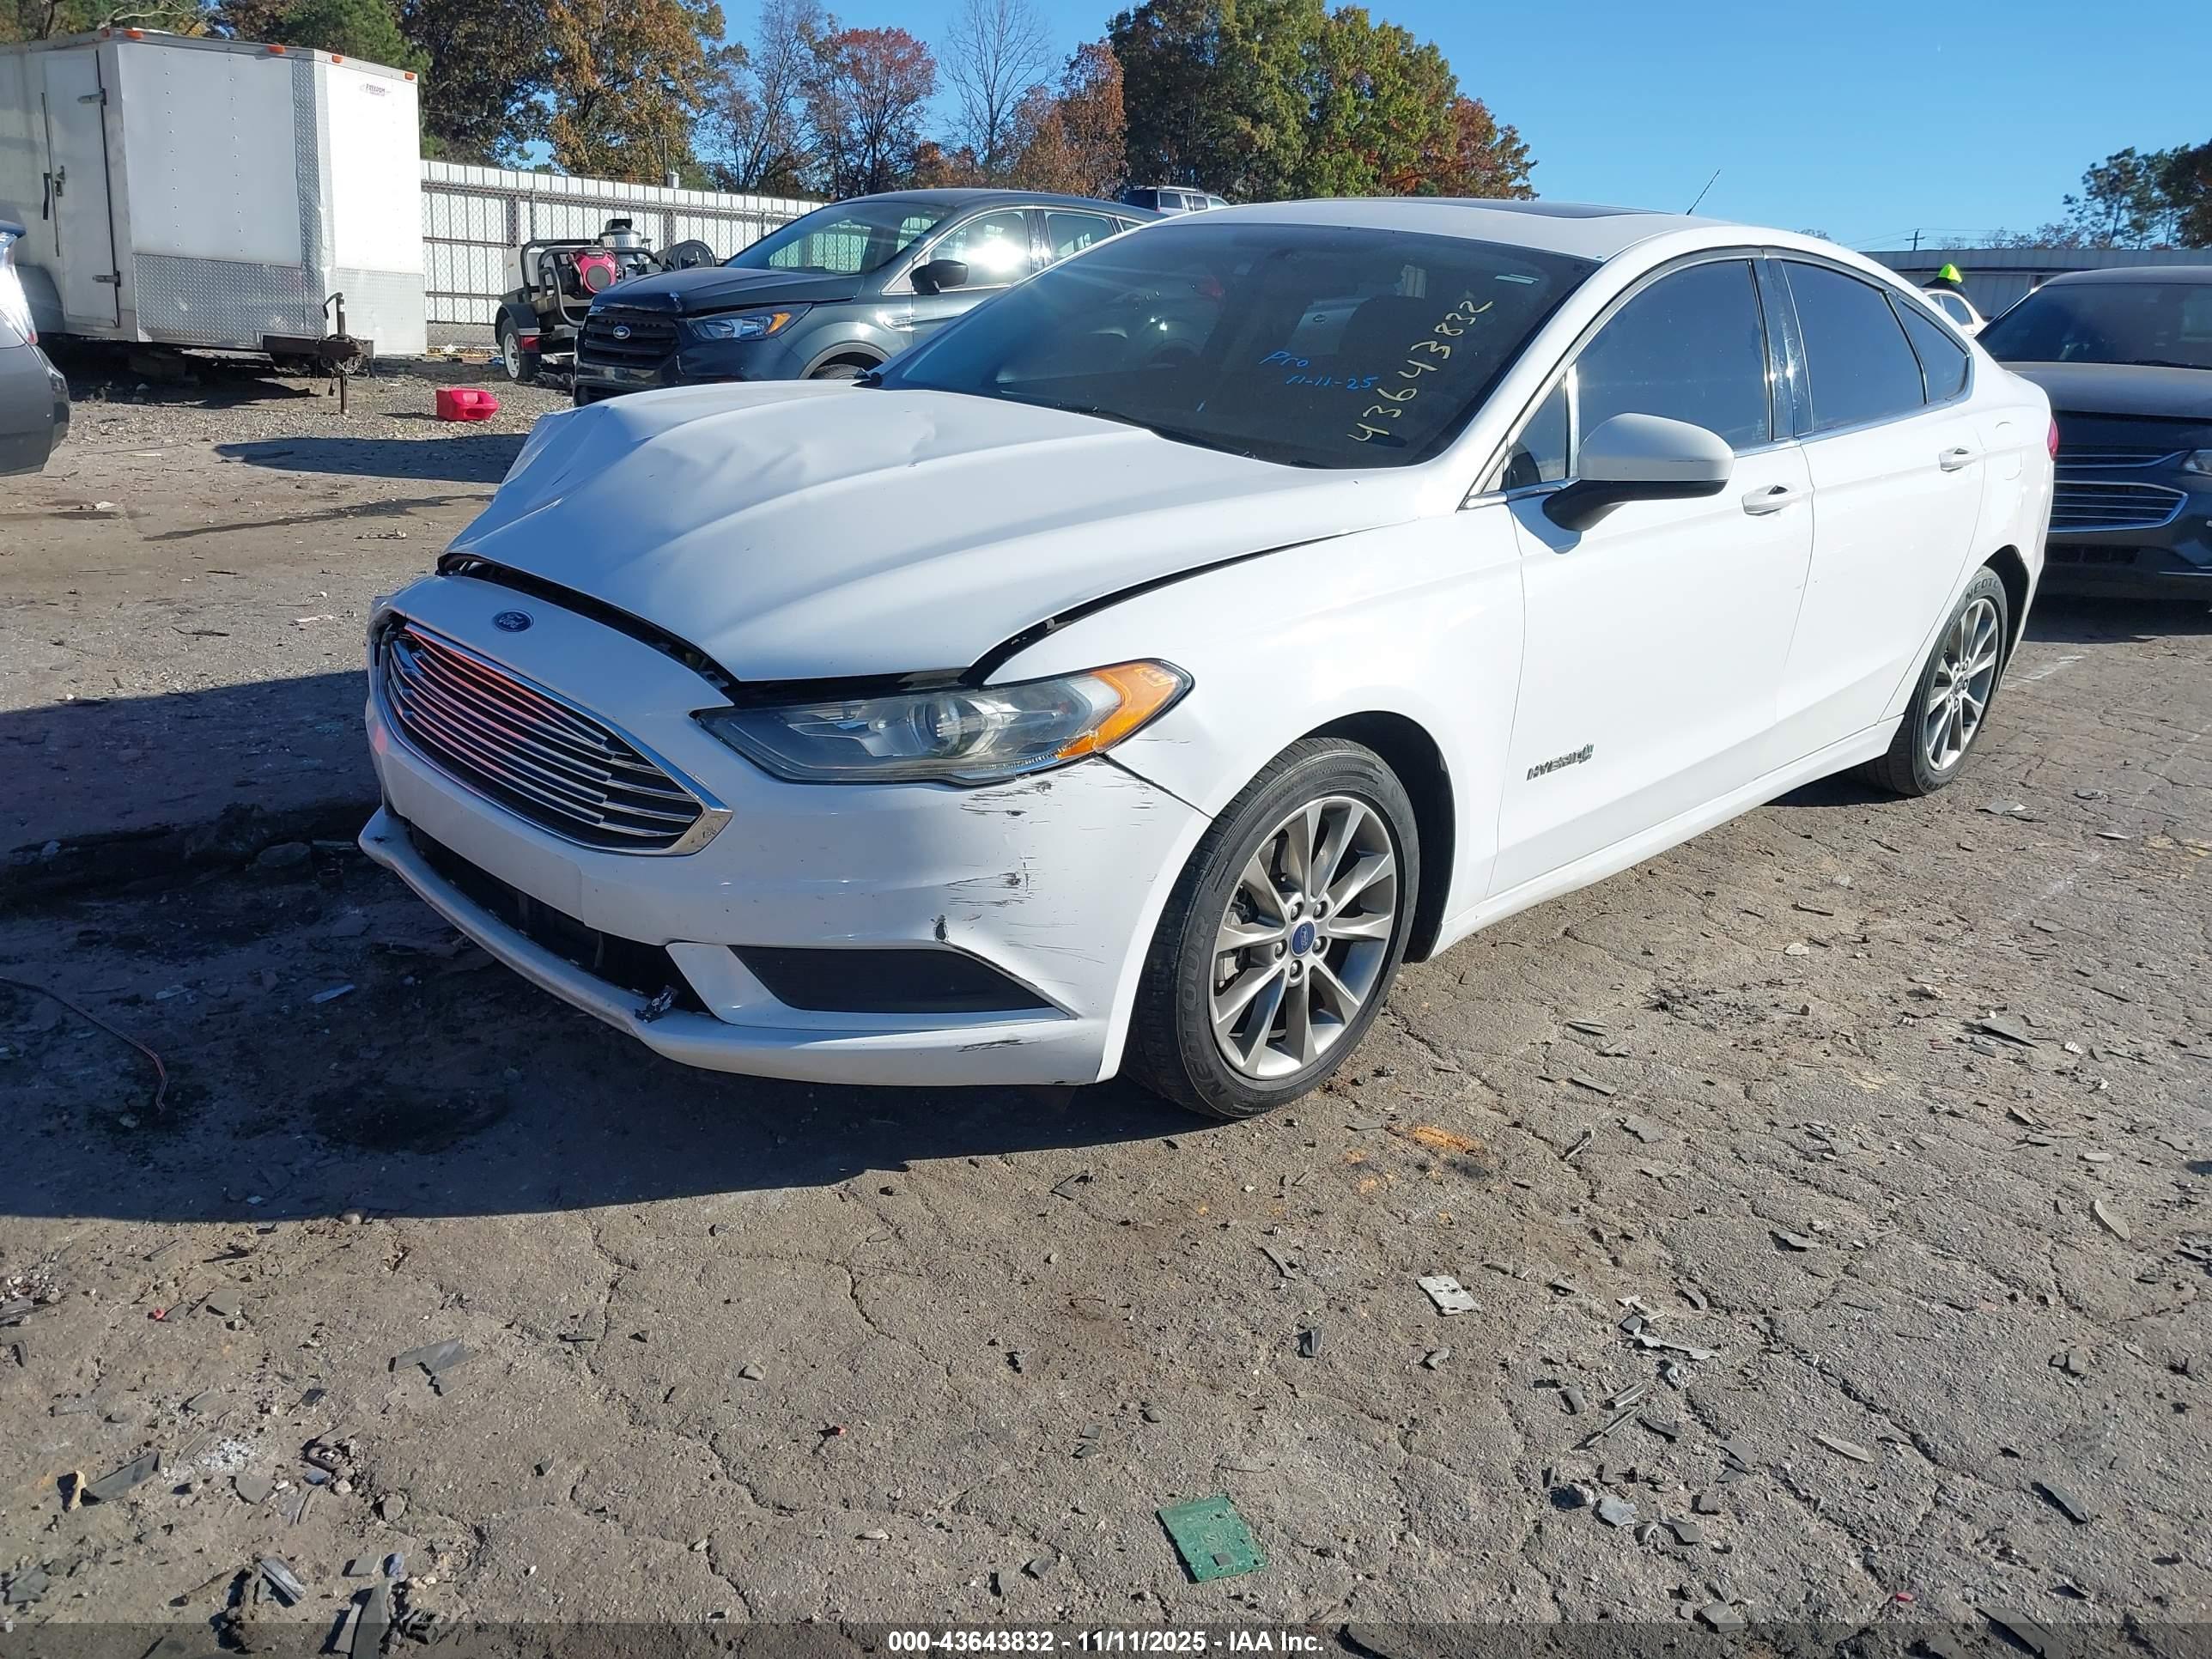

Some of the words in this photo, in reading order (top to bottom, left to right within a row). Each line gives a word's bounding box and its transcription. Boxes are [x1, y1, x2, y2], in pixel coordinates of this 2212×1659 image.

[1285, 375, 1379, 390] 11-11-25
[1347, 300, 1494, 442] 43643832
[1966, 577, 2002, 604] NEOTO
